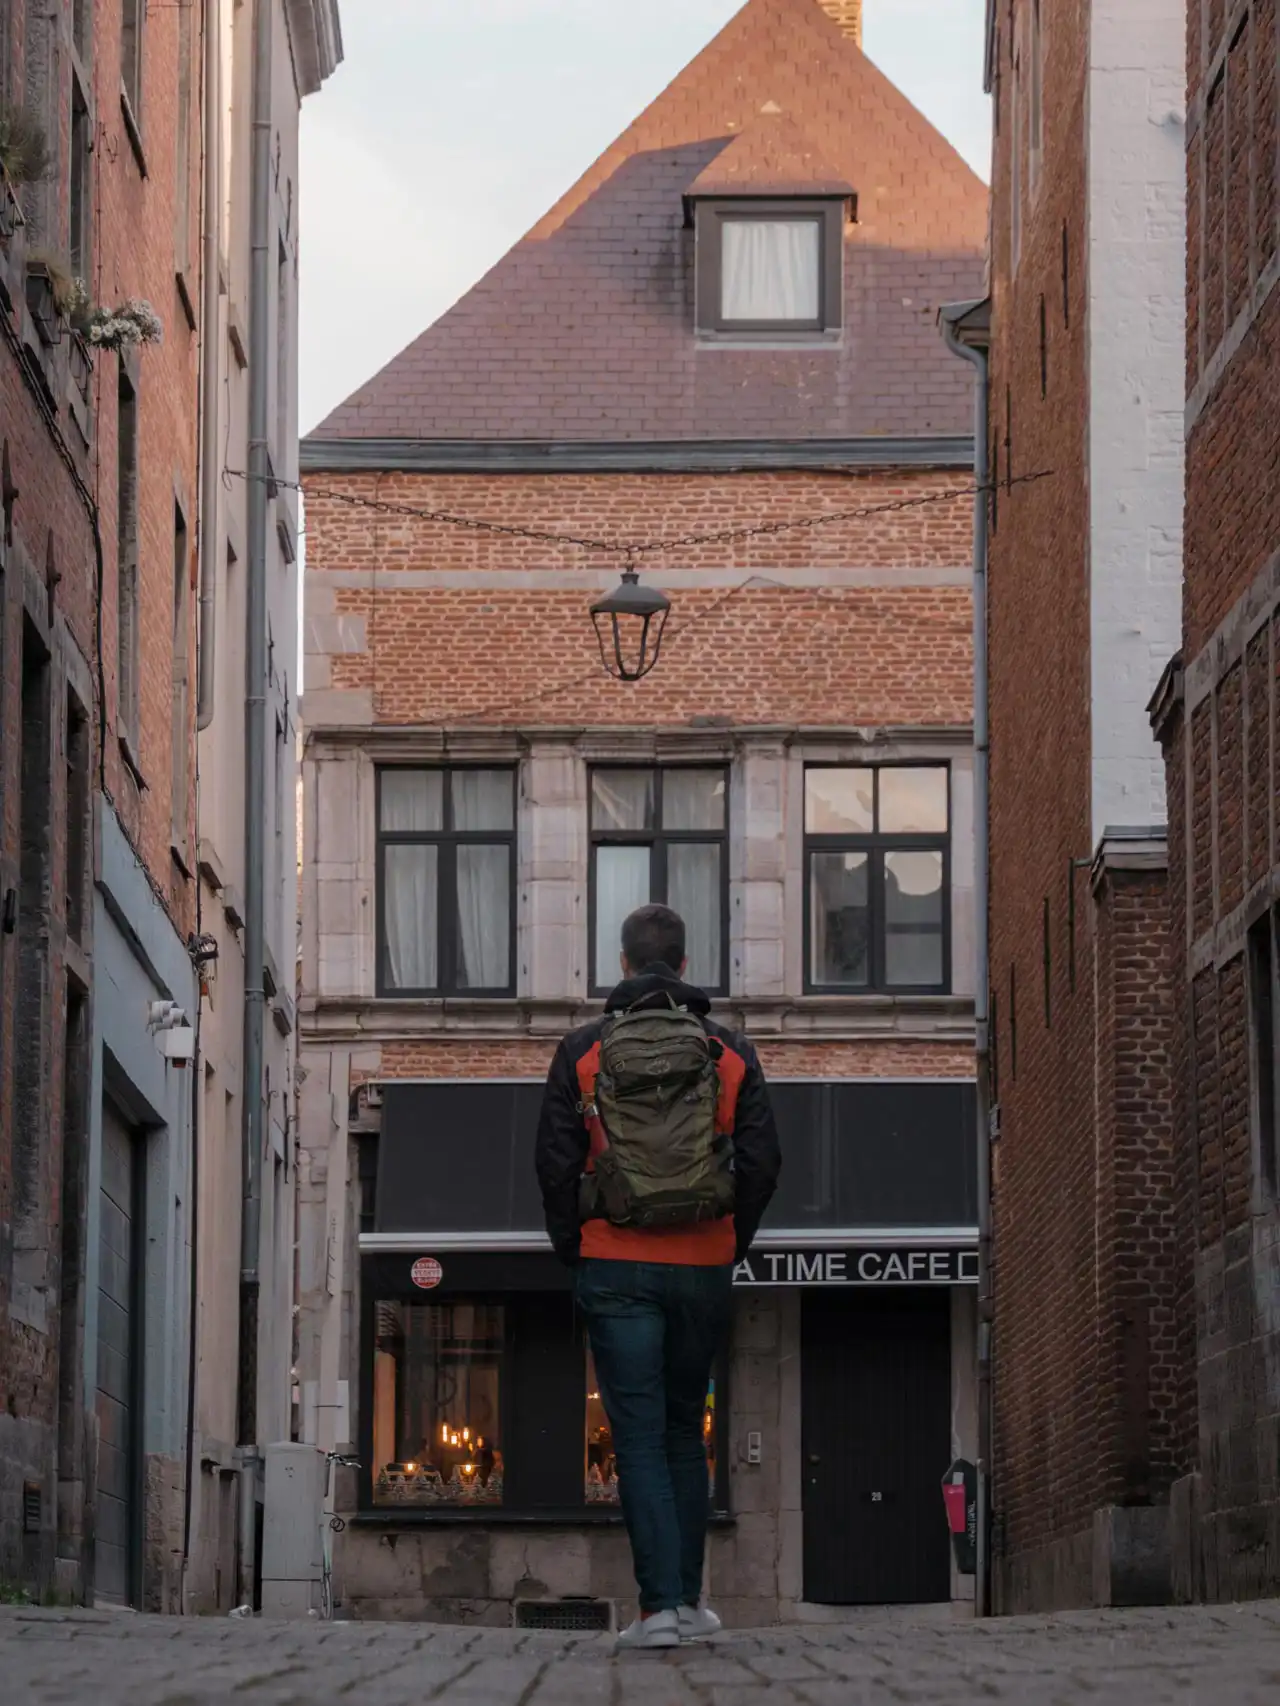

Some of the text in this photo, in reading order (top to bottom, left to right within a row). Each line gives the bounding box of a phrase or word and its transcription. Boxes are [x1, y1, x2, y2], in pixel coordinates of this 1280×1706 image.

[732, 1256, 756, 1281] A
[763, 1253, 848, 1281] TIME
[857, 1252, 950, 1280] CAFE
